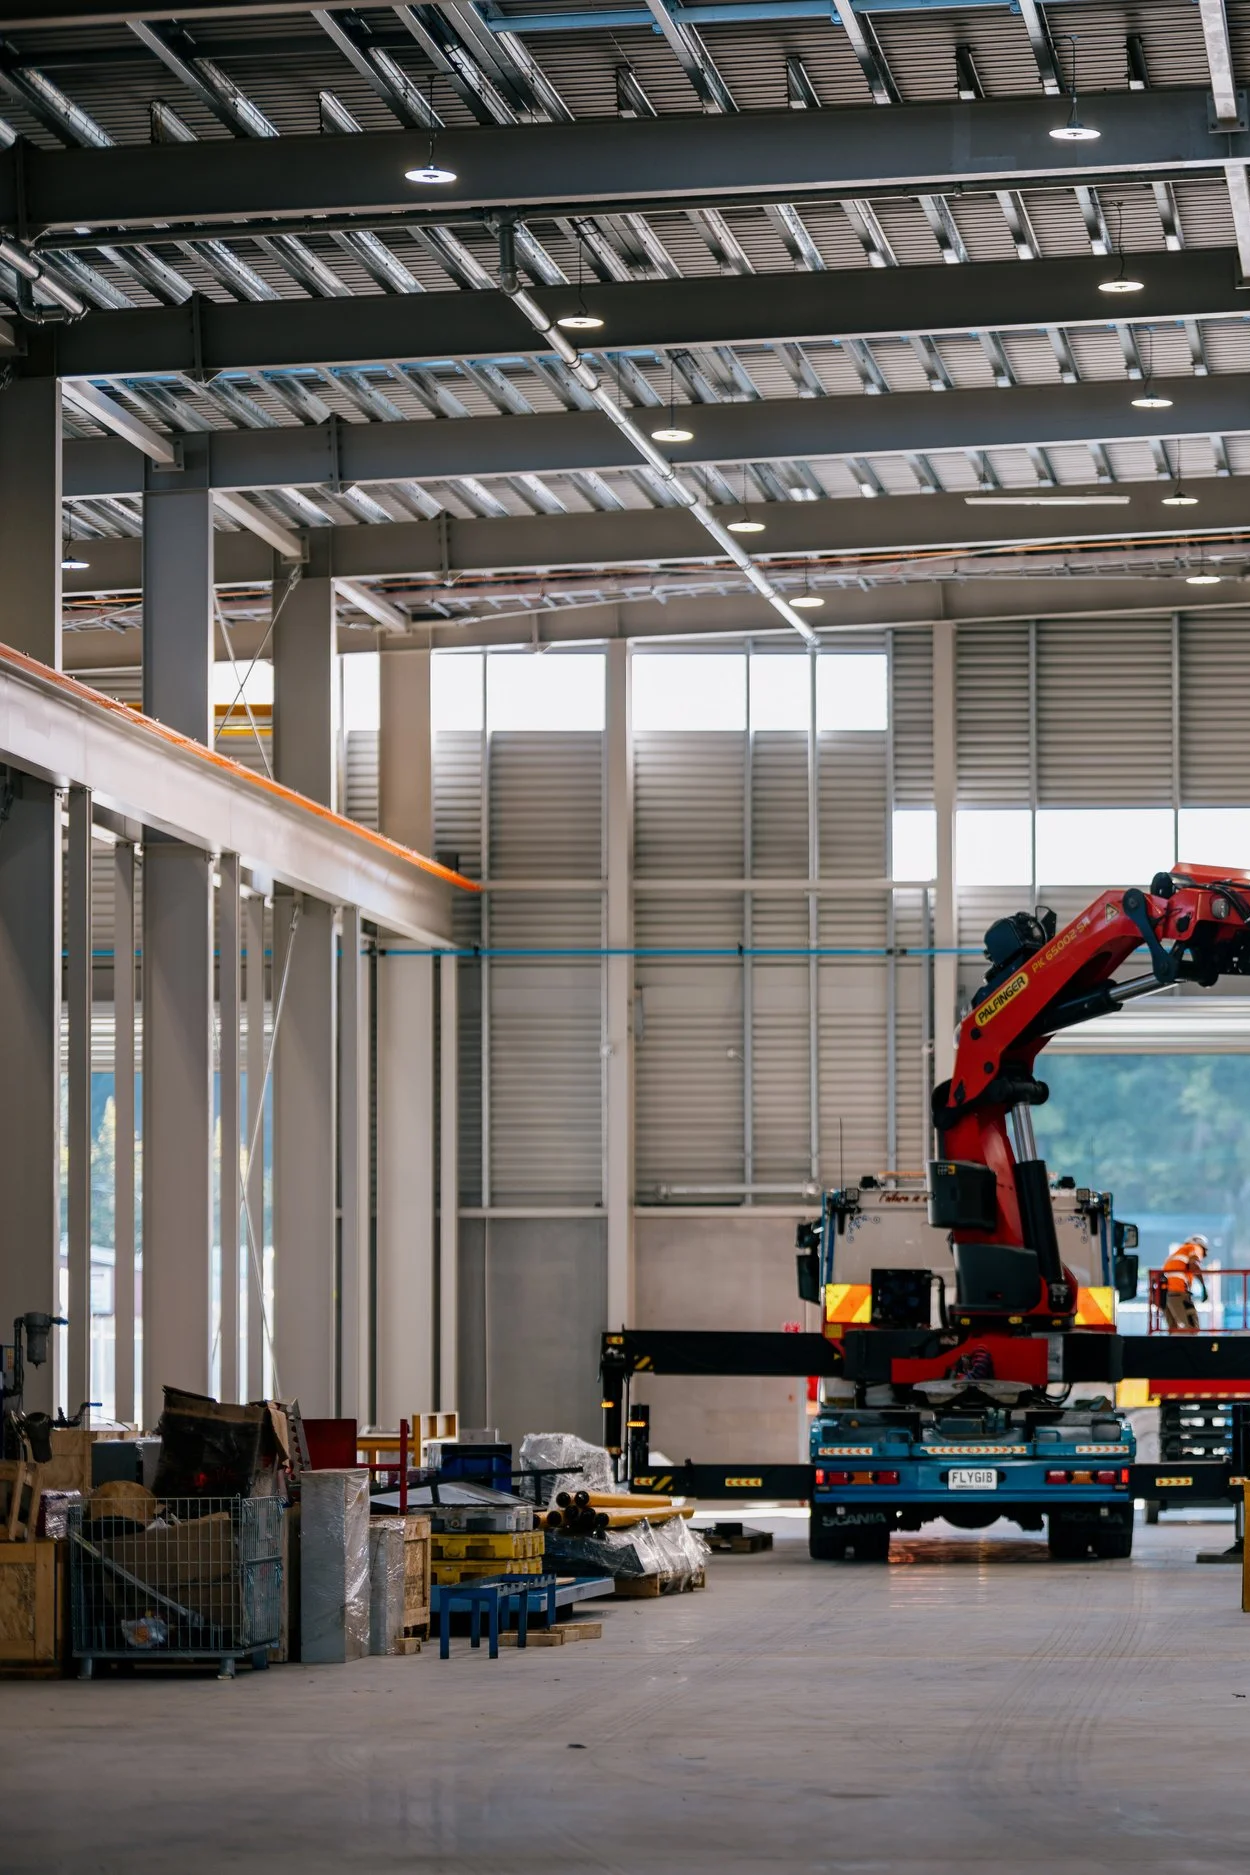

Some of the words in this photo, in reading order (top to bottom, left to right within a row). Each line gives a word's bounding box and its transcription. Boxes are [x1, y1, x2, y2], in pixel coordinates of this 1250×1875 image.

[1031, 957, 1046, 973] PK
[1045, 928, 1077, 961] 65002
[977, 976, 1026, 1024] PALFINGER
[821, 1513, 887, 1527] SCANIA
